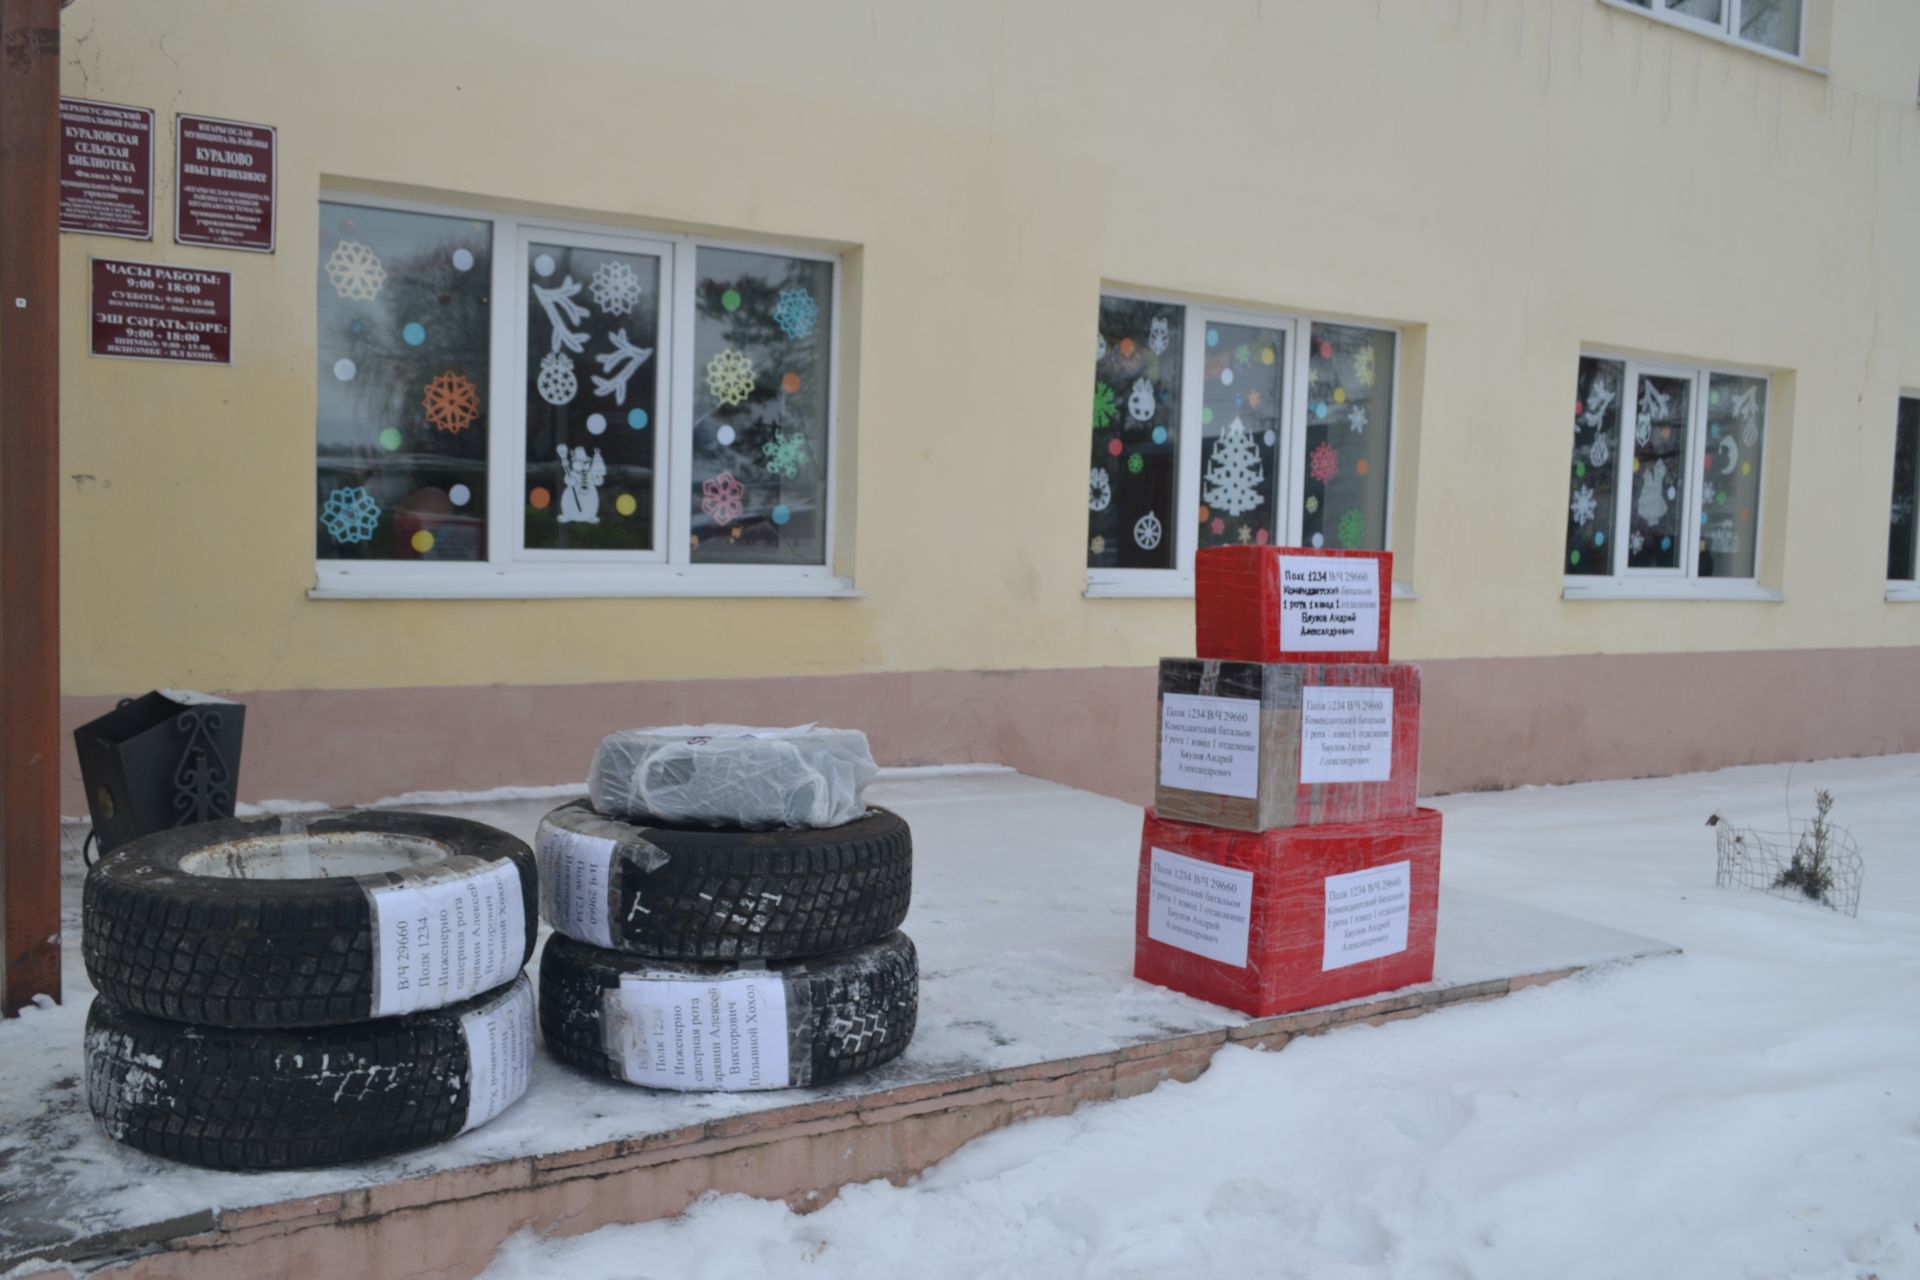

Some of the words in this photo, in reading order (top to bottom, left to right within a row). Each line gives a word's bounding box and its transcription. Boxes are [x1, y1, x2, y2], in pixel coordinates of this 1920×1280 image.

[65, 125, 138, 146] КУРАЛОВСКАЯ
[75, 141, 128, 158] СЕЛЬСКАЯ
[68, 154, 135, 172] БИБЛИОТЕКА
[195, 146, 253, 166] КУРАЛОВО
[105, 263, 151, 277] ЧАСЫ
[155, 268, 220, 285] РАБОТЫ:
[126, 278, 154, 289] 9:00
[167, 282, 200, 294] 18:00
[111, 290, 163, 302] СУББОТА:
[96, 312, 122, 324] ЭШ
[125, 327, 154, 338] 9:00
[166, 331, 199, 342] 18:00
[1284, 569, 1305, 580] Полк
[1308, 570, 1326, 581] 1234
[1166, 706, 1185, 717] Полк
[1187, 708, 1205, 719] 1234
[1223, 710, 1248, 723] 29660
[455, 897, 467, 928] рота
[467, 883, 481, 937] Алексей
[396, 920, 409, 961] 29660
[418, 916, 430, 947] 1234
[485, 895, 497, 975] Викторович
[438, 909, 451, 987] Инженерно
[456, 930, 468, 990] саперная
[397, 966, 409, 991] В/Ч
[418, 954, 430, 988] Полк
[691, 998, 703, 1025] рота
[708, 987, 722, 1038] Алексей
[746, 984, 759, 1023] Хохол
[674, 1005, 685, 1076] Инженерно
[728, 1000, 741, 1075] Викторович
[655, 1041, 666, 1072] Полк
[694, 1027, 704, 1082] саперная
[747, 1028, 760, 1087] Позывной
